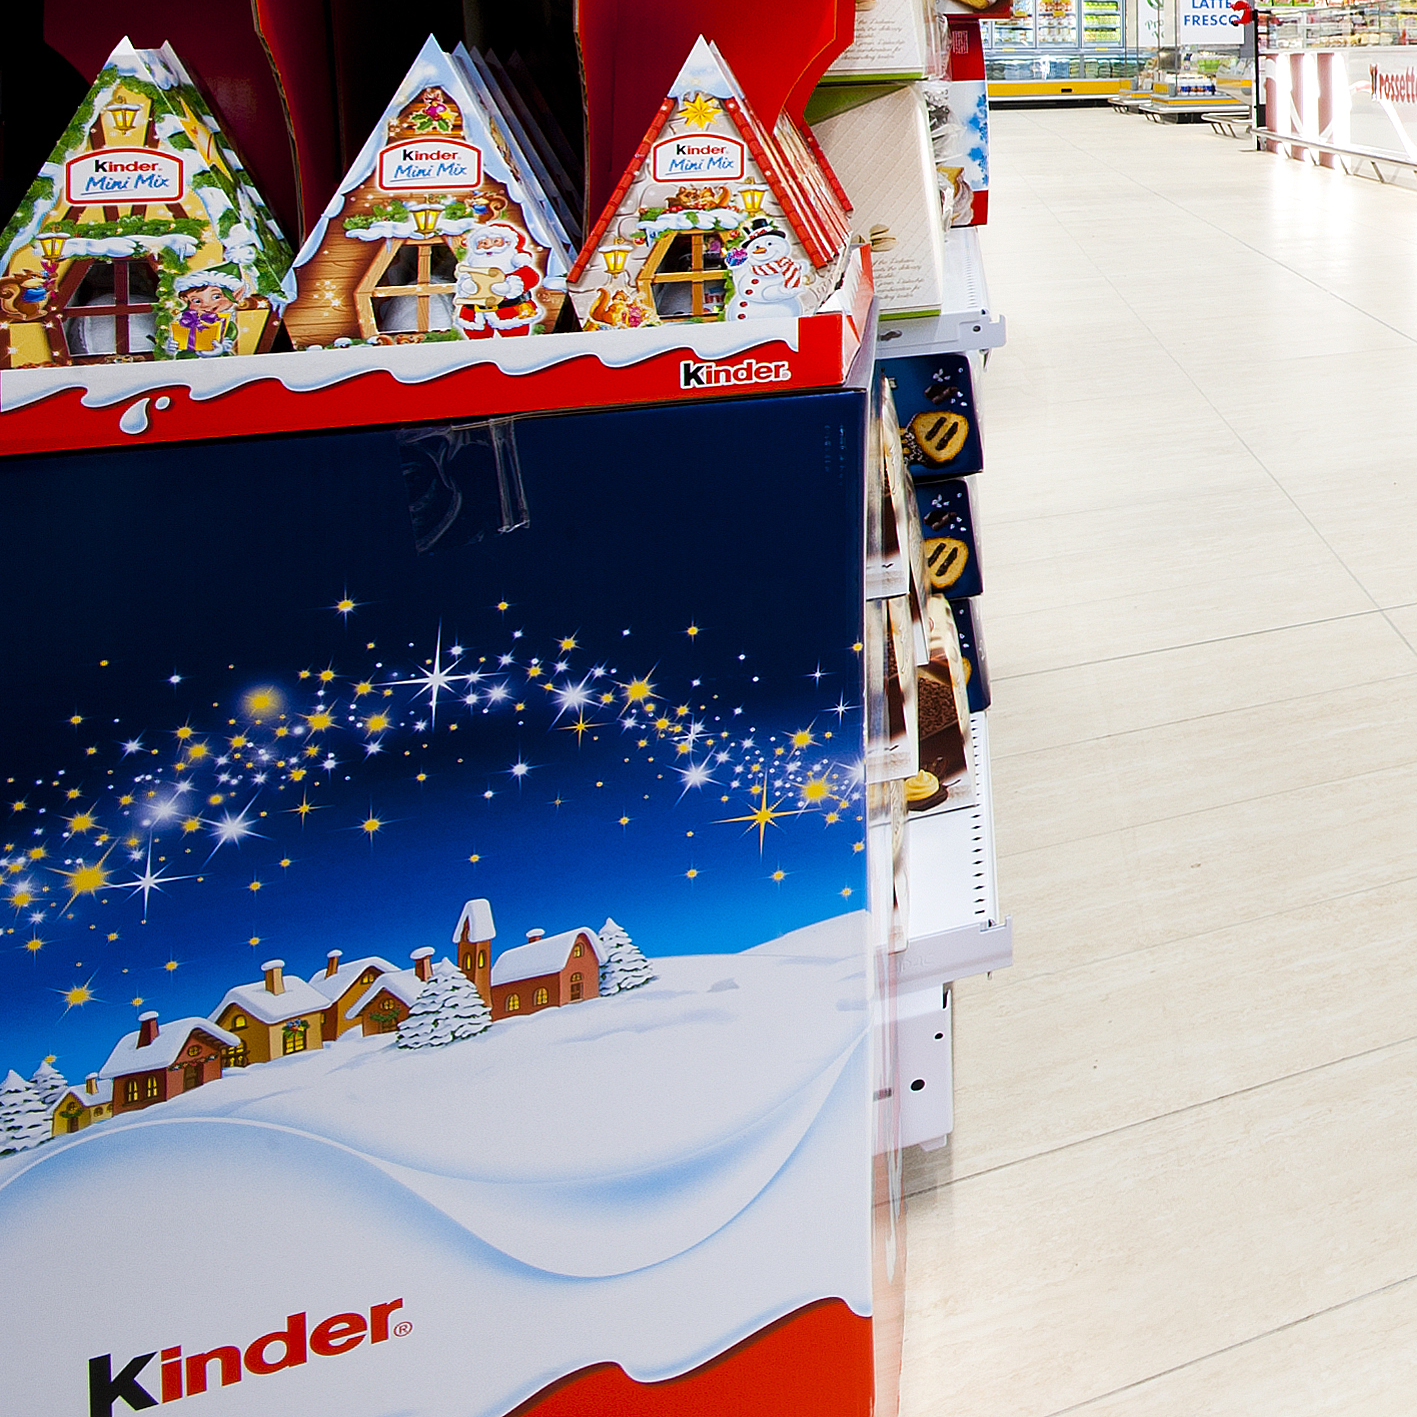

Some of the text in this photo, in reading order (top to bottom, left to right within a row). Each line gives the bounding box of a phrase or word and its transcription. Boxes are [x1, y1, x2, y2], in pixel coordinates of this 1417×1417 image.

[1184, 14, 1241, 27] FRESCO
[133, 173, 170, 189] Mix
[682, 362, 790, 387] Kinder
[88, 1298, 404, 1417] Kinder
